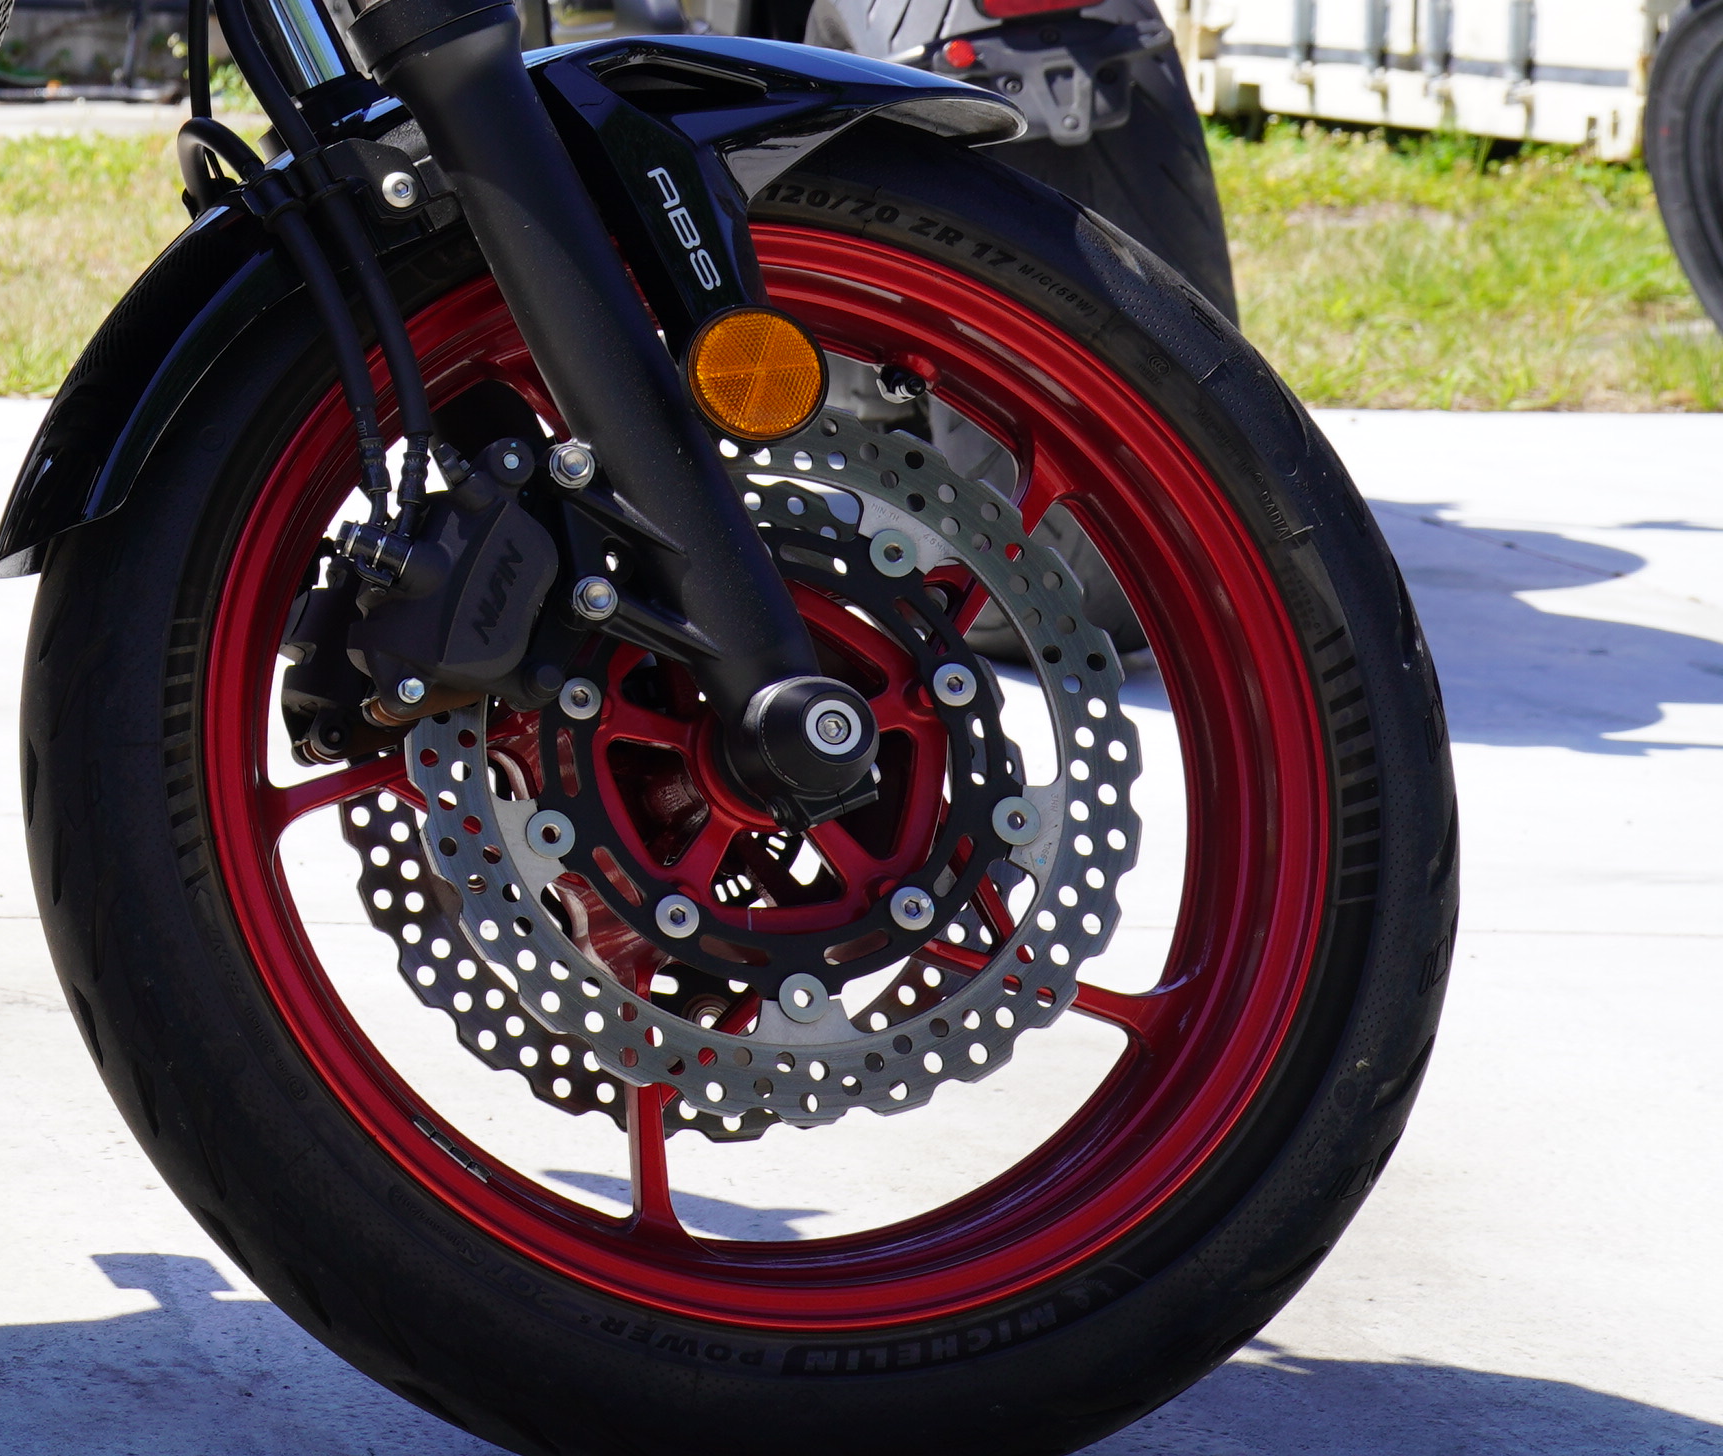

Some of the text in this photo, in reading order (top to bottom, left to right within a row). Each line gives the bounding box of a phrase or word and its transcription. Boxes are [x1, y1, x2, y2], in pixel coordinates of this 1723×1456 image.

[646, 167, 723, 291] ABS
[763, 181, 900, 226] 120/70
[908, 214, 964, 247] ZR
[969, 241, 1019, 268] 17
[606, 1317, 763, 1369] POWER
[801, 1304, 1059, 1375] MICHELIN
